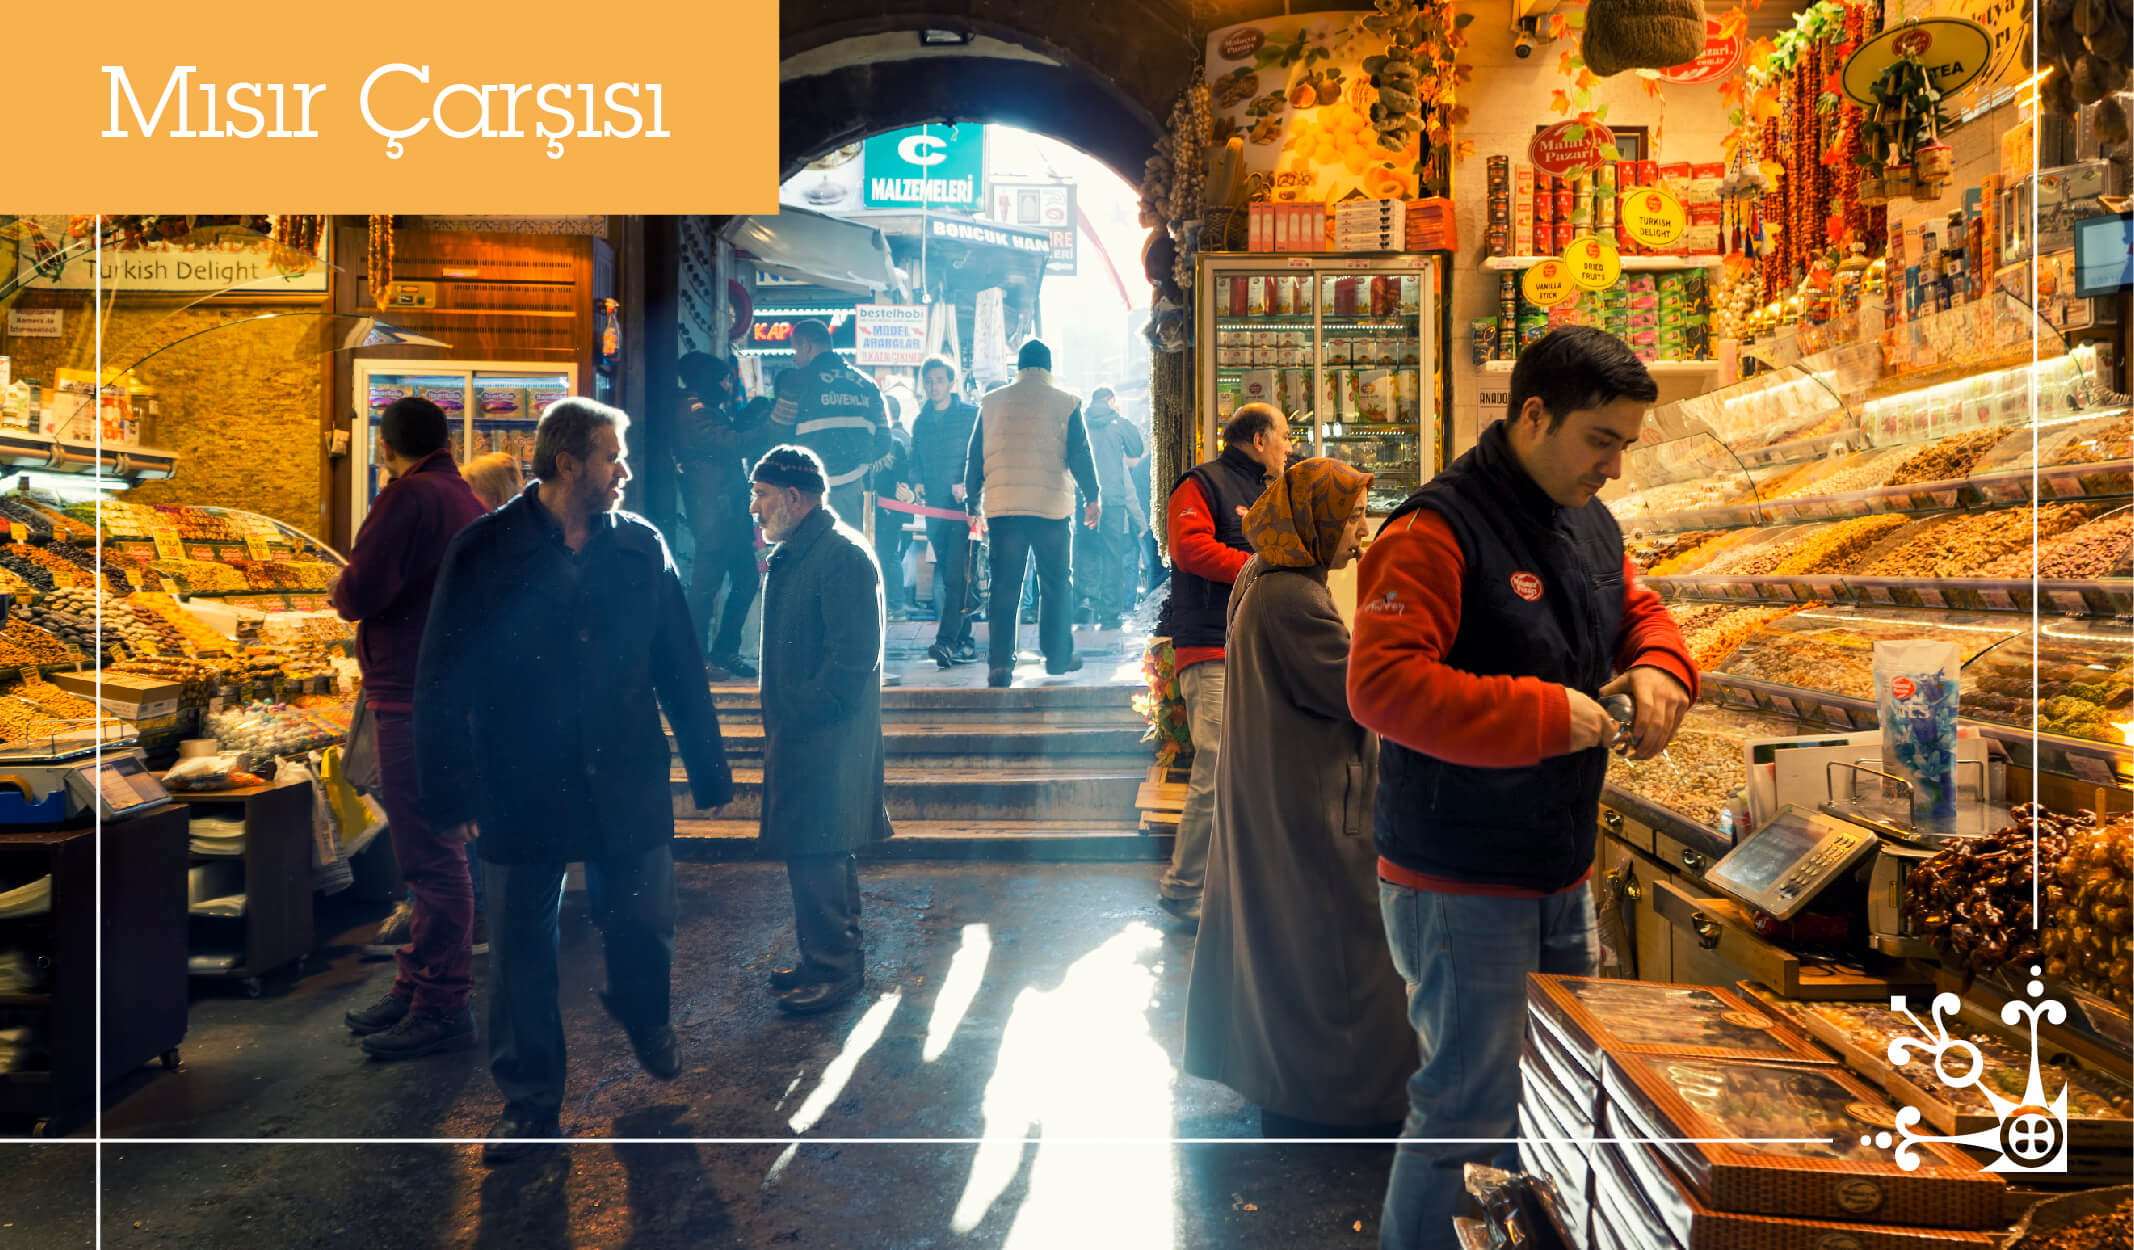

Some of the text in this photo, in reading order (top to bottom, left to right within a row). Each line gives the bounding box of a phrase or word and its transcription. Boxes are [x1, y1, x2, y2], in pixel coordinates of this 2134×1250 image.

[1929, 61, 1964, 79] TEA
[871, 174, 974, 204] MALZEMELERİ
[1639, 216, 1671, 227] TURKISH
[932, 221, 1009, 247] BONCUK
[1640, 228, 1671, 239] DELIGHT
[83, 259, 260, 285] Turkish Delight
[1584, 262, 1604, 272] DRIED
[1582, 272, 1605, 281] FRUITS
[1536, 282, 1562, 291] VANILLA
[1539, 292, 1558, 300] STICK
[753, 321, 794, 341] KAP
[873, 325, 909, 337] MODEL
[1480, 392, 1513, 405] ANADO
